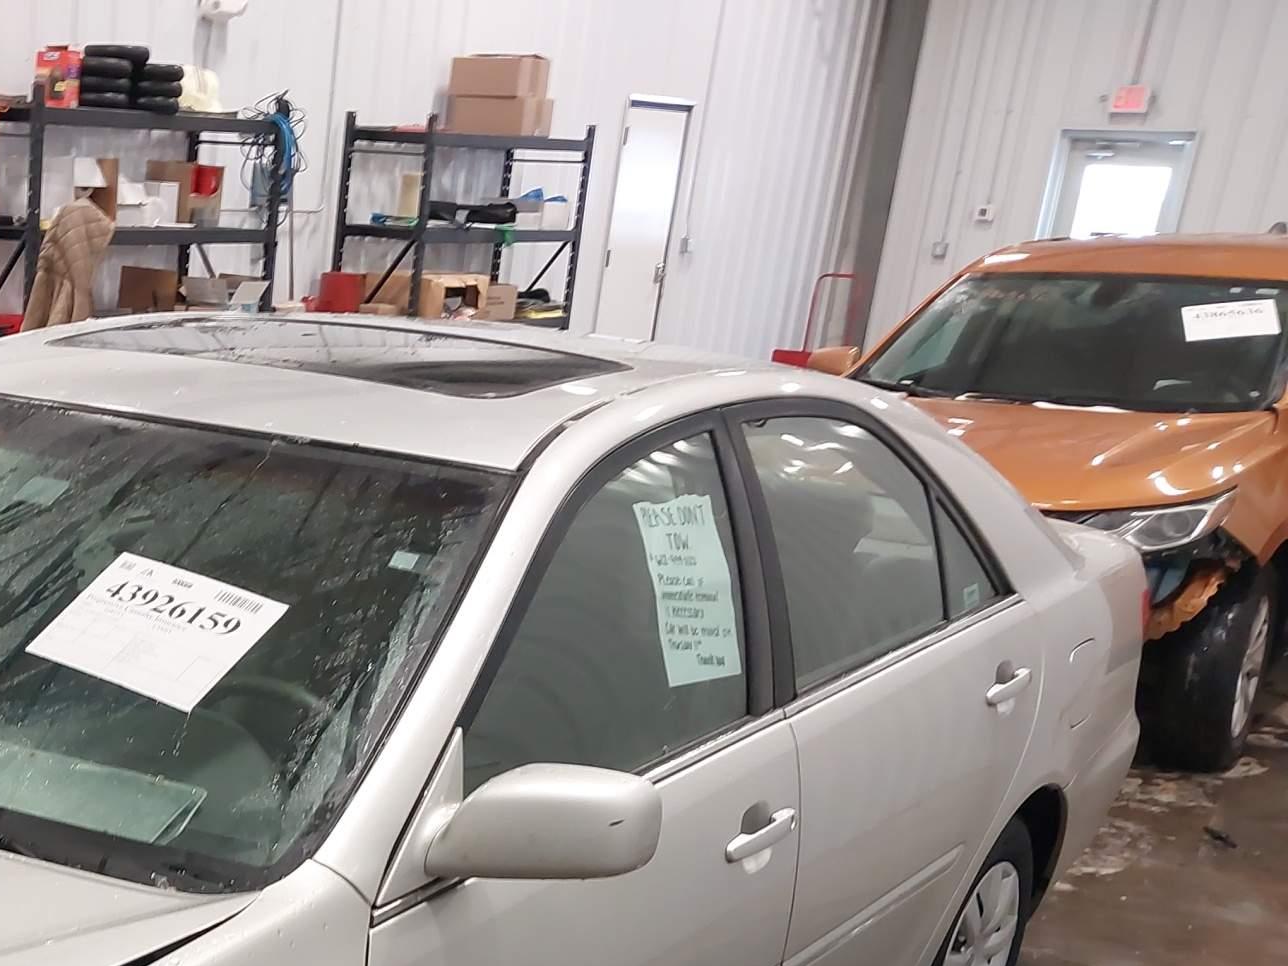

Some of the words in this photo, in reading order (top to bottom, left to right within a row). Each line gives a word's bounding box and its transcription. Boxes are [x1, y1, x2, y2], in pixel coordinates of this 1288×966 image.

[640, 505, 676, 528] PLEASE
[665, 532, 689, 550] TOW
[106, 580, 241, 635] 43926159
